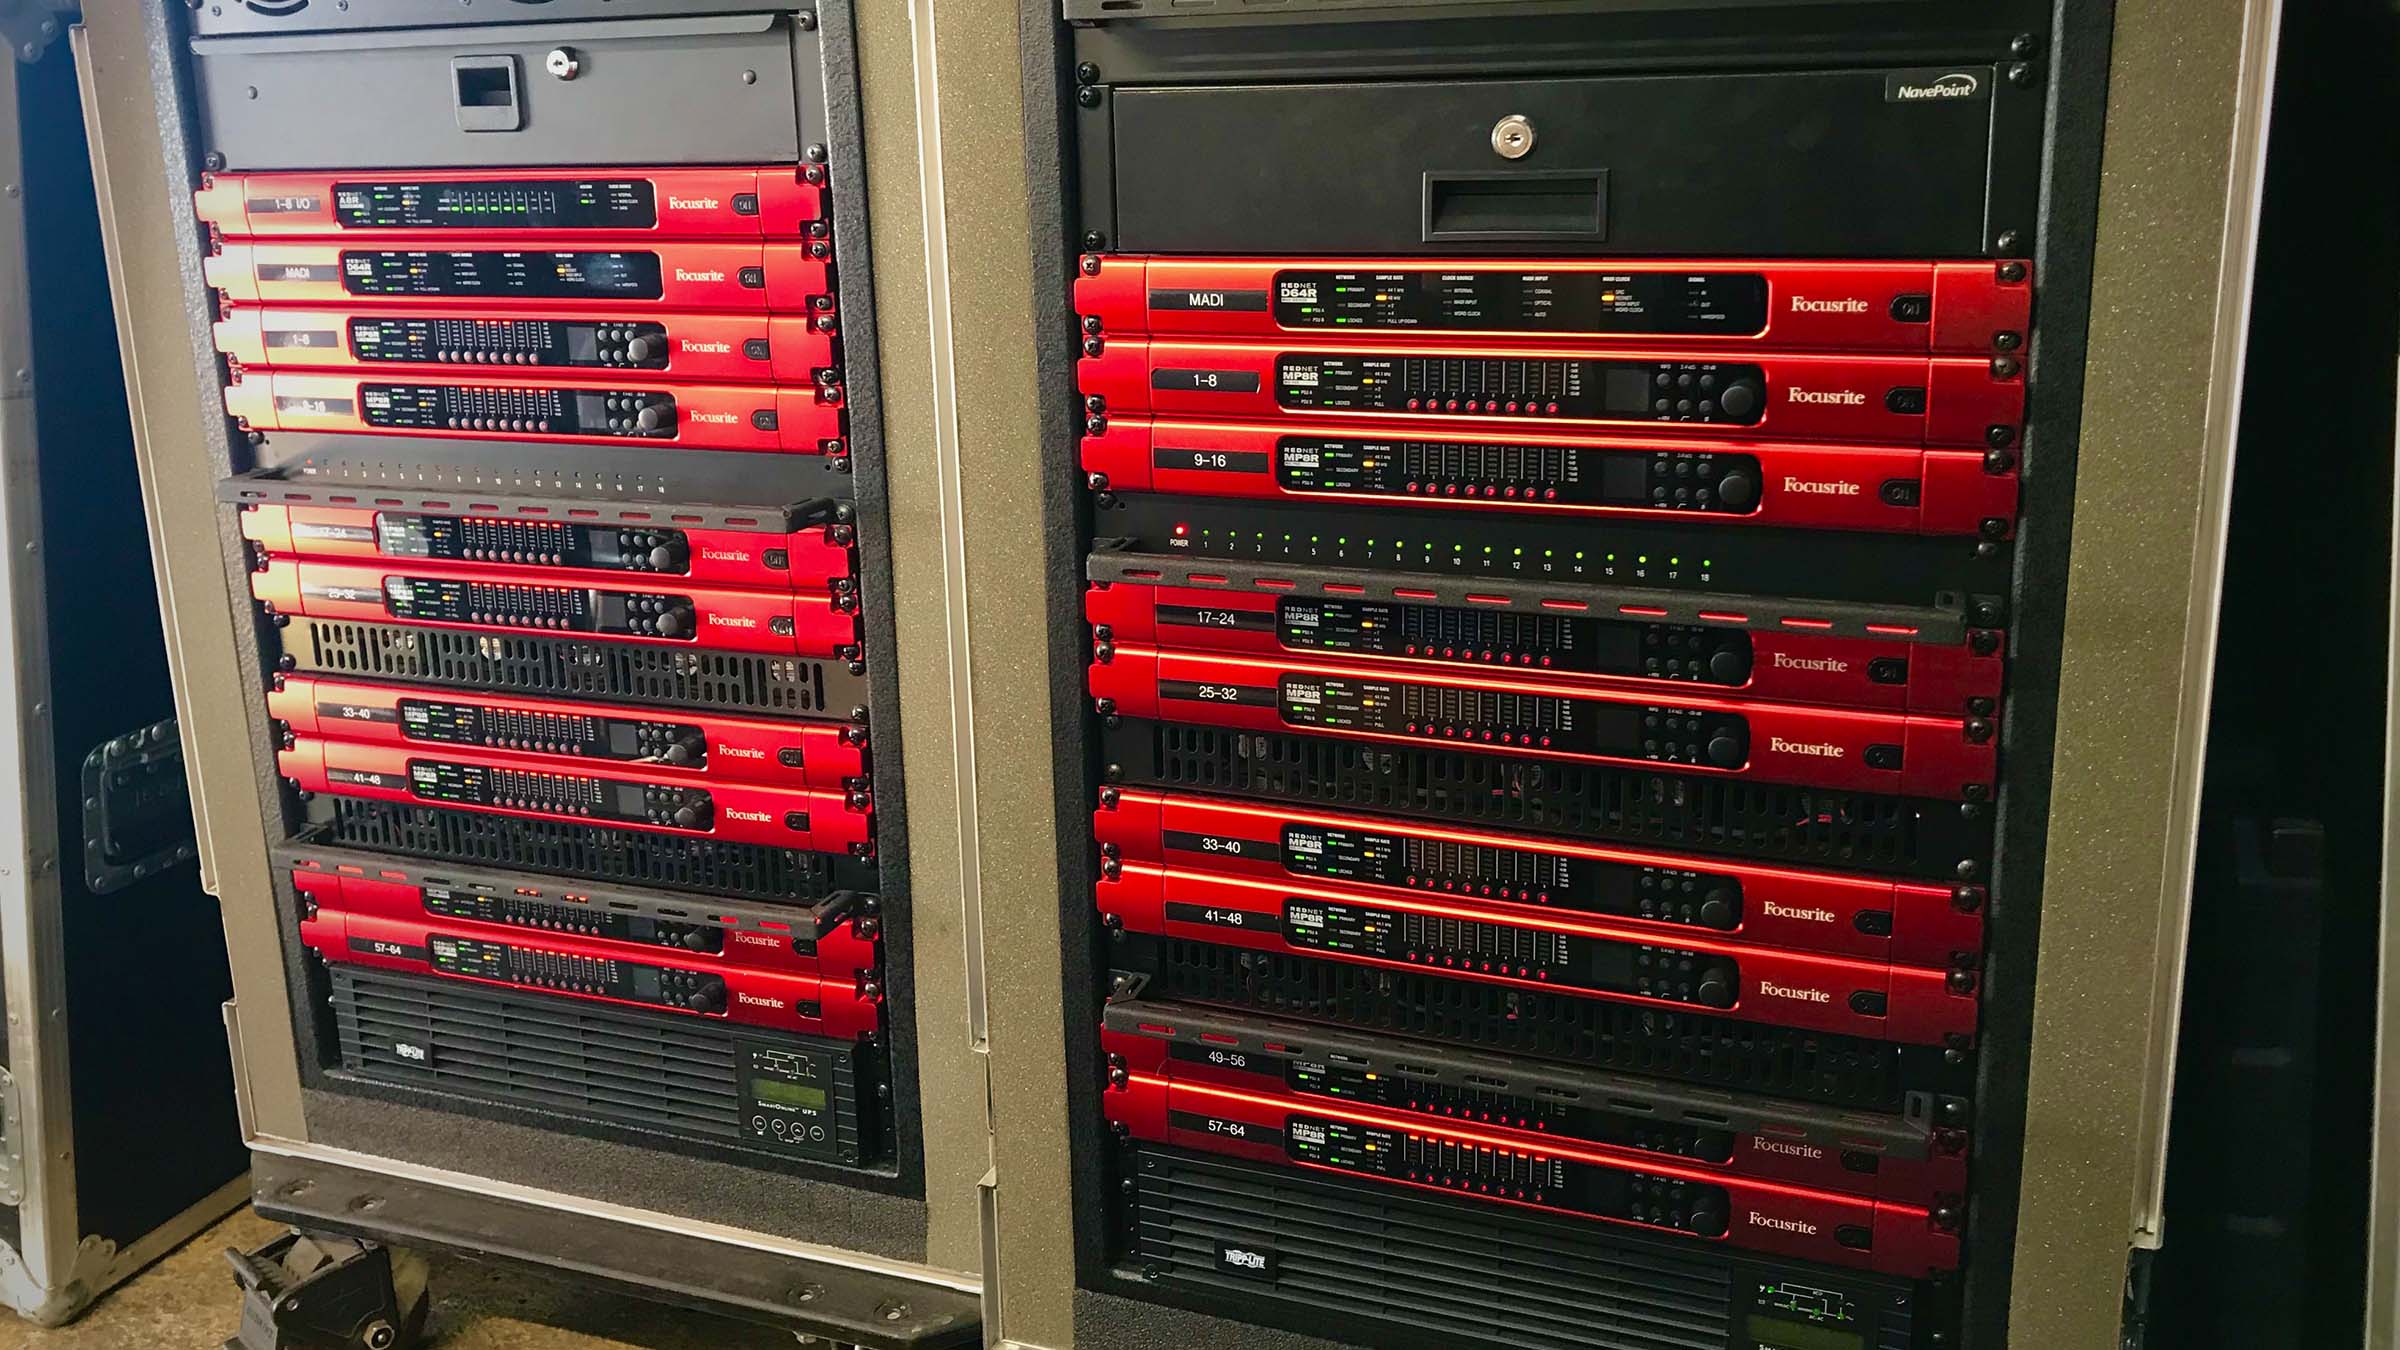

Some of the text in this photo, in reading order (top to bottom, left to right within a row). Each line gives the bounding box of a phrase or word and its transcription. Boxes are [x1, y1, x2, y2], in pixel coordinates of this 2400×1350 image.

[1898, 83, 1971, 98] NavePoint
[669, 196, 718, 210] Focusrite
[285, 266, 309, 279] MADI
[676, 268, 725, 282] Focusrite
[1189, 293, 1224, 306] MADI
[1281, 288, 1317, 298] D64R
[1791, 296, 1868, 312] Focusrite
[292, 333, 310, 346] 1-8
[681, 339, 730, 354] Focusrite
[1193, 374, 1217, 387] 1-8
[1283, 372, 1318, 380] MP8R
[1788, 387, 1865, 405] Focusrite
[690, 410, 738, 424] Focusrite
[1194, 453, 1226, 468] 9-16
[1284, 453, 1319, 462] MP8R
[1784, 476, 1860, 495] Focusrite
[702, 548, 749, 562] Focusrite
[1230, 542, 1234, 550] 2
[1257, 544, 1261, 552] 3
[1311, 547, 1316, 555] 5
[1339, 549, 1344, 557] 6
[1368, 551, 1372, 559] 7
[1396, 553, 1401, 561] 8
[1425, 555, 1429, 563] 9
[1453, 557, 1461, 566] 10
[1483, 559, 1490, 567] 11
[1513, 561, 1521, 569] 12
[1543, 563, 1551, 571] 13
[1574, 565, 1583, 573] 14
[1605, 567, 1613, 575] 15
[1636, 569, 1645, 577] 16
[1669, 571, 1677, 579] 17
[1701, 573, 1710, 582] 18
[709, 614, 756, 628] Focusrite
[1197, 611, 1235, 625] 17-24
[1284, 613, 1319, 621] MP8R
[1774, 652, 1848, 672] Focusrite
[1199, 686, 1237, 700] 25-32
[1286, 689, 1320, 699] MP8R
[343, 707, 370, 719] 33-40
[719, 744, 764, 759] Focusrite
[1771, 737, 1844, 757] Focusrite
[353, 773, 381, 785] 41-48
[726, 808, 771, 823] Focusrite
[1288, 832, 1322, 840] REDNET
[1202, 838, 1241, 853] 33-40
[1288, 838, 1322, 849] MP8R
[1204, 909, 1243, 925] 41-48
[1290, 906, 1323, 915] REDNET
[1290, 912, 1323, 923] MP8R
[1763, 901, 1835, 922] Focusrite
[735, 931, 780, 947] Focusrite
[375, 943, 401, 954] 57-64
[1760, 981, 1830, 1003] Focusrite
[739, 992, 784, 1009] Focusrite
[1208, 1051, 1246, 1067] 49-56
[1208, 1120, 1245, 1137] 57-64
[1293, 1122, 1325, 1132] REDNET
[1293, 1128, 1325, 1140] MP8R
[1753, 1136, 1822, 1159] Focusrite
[1749, 1211, 1817, 1236] Focusrite
